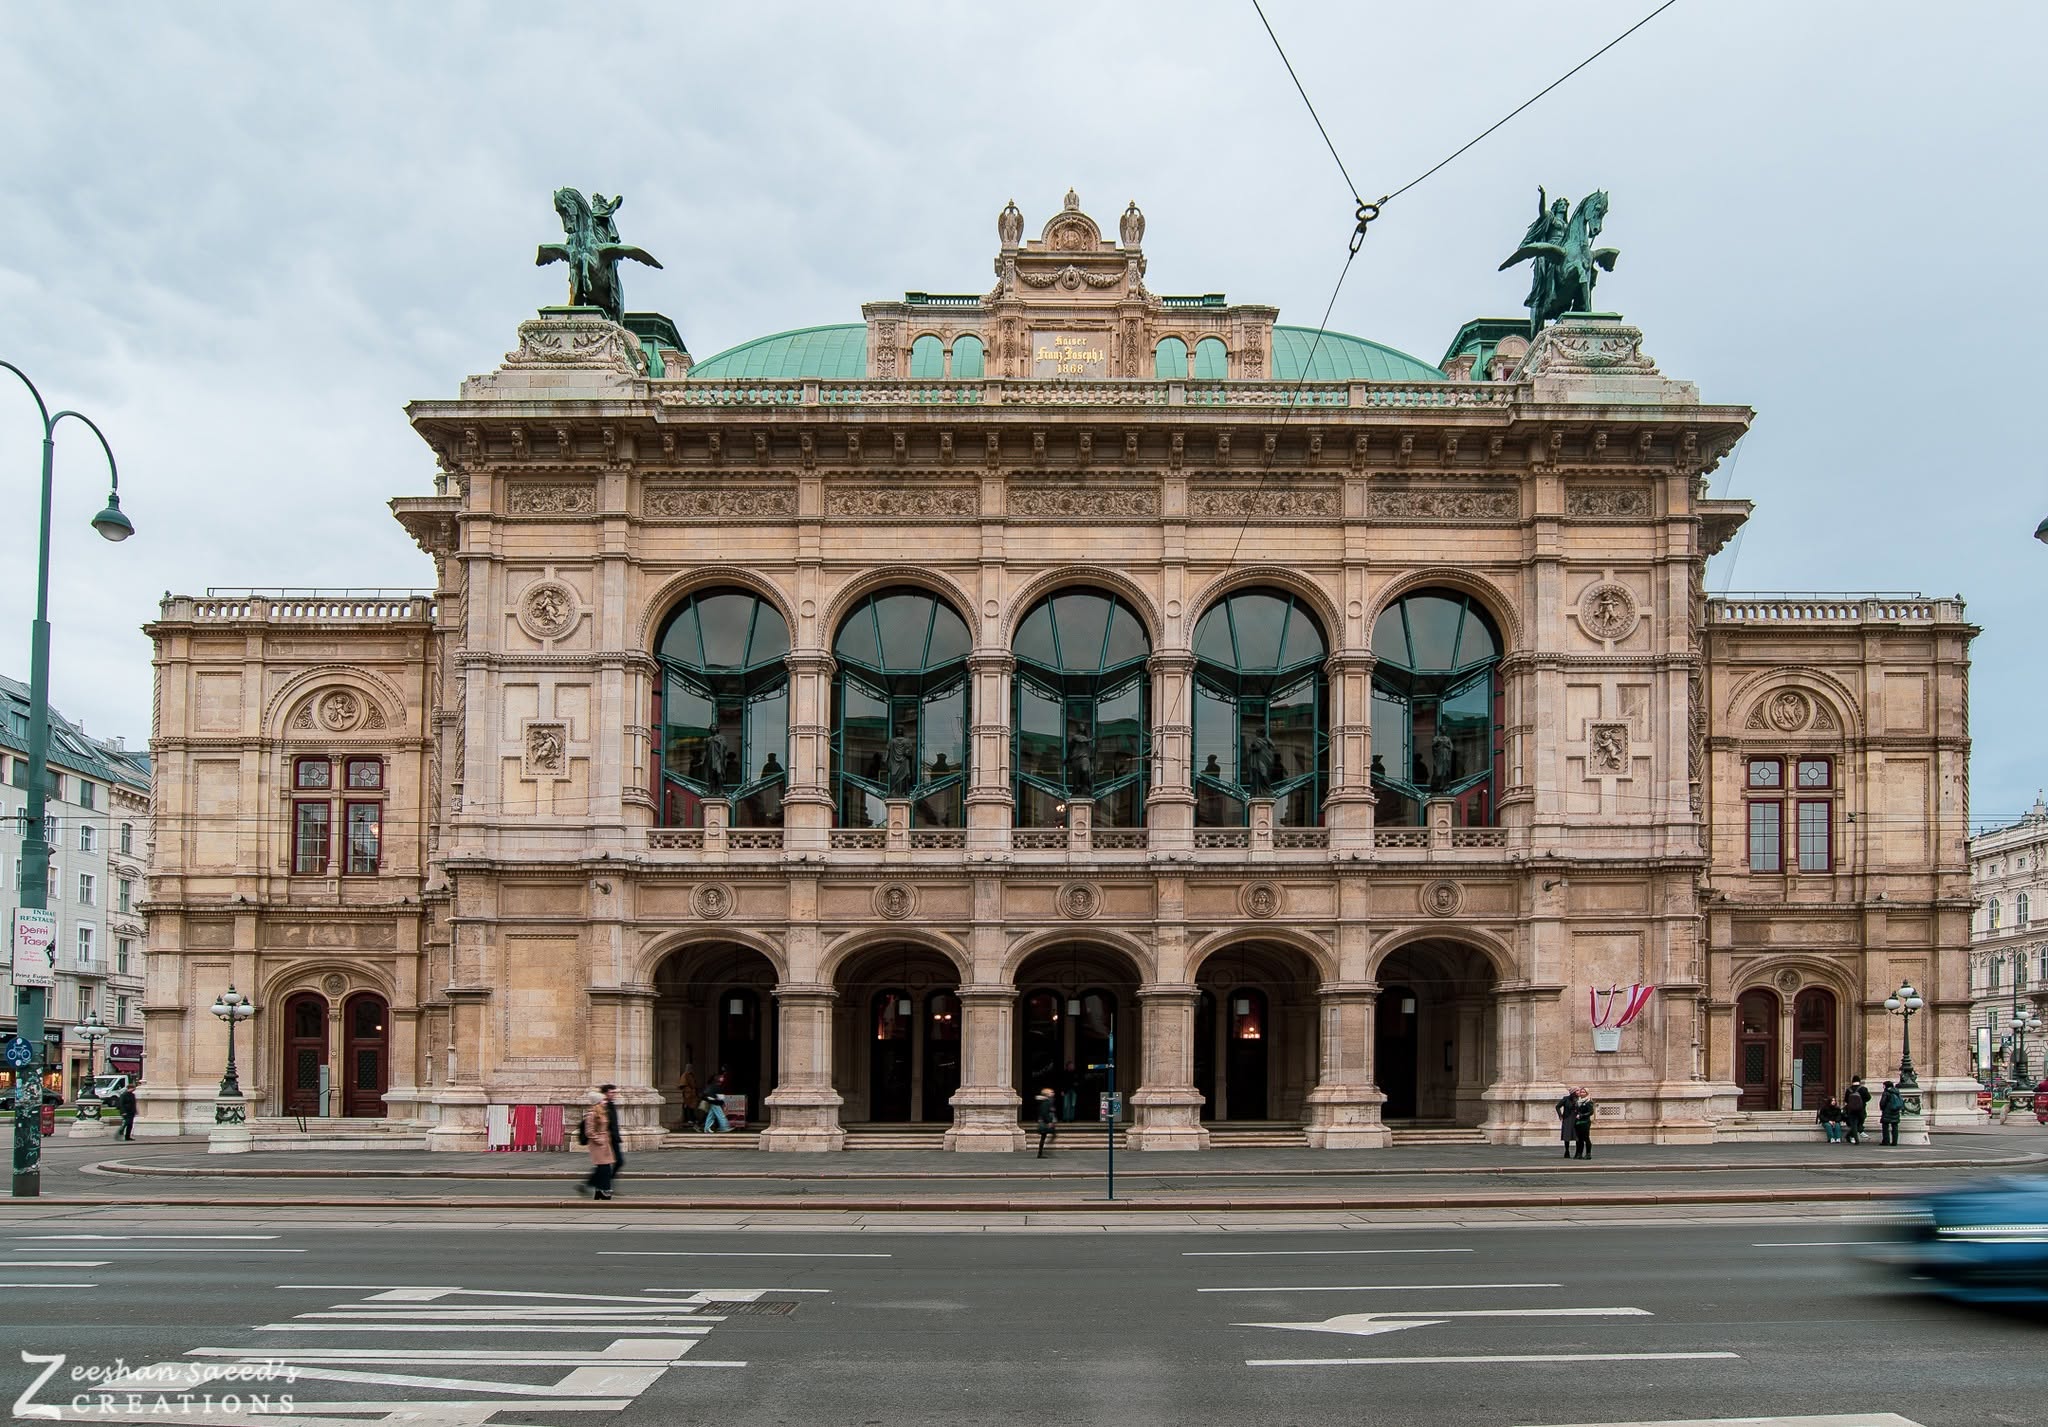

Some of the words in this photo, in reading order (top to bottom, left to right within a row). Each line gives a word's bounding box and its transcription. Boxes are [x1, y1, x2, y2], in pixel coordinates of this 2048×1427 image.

[1055, 336, 1087, 346] Kaiser
[1035, 346, 1063, 364] Franz
[1063, 346, 1098, 364] Joseph
[1056, 363, 1084, 374] 1868
[19, 924, 48, 935] Demi
[19, 935, 48, 947] Tass
